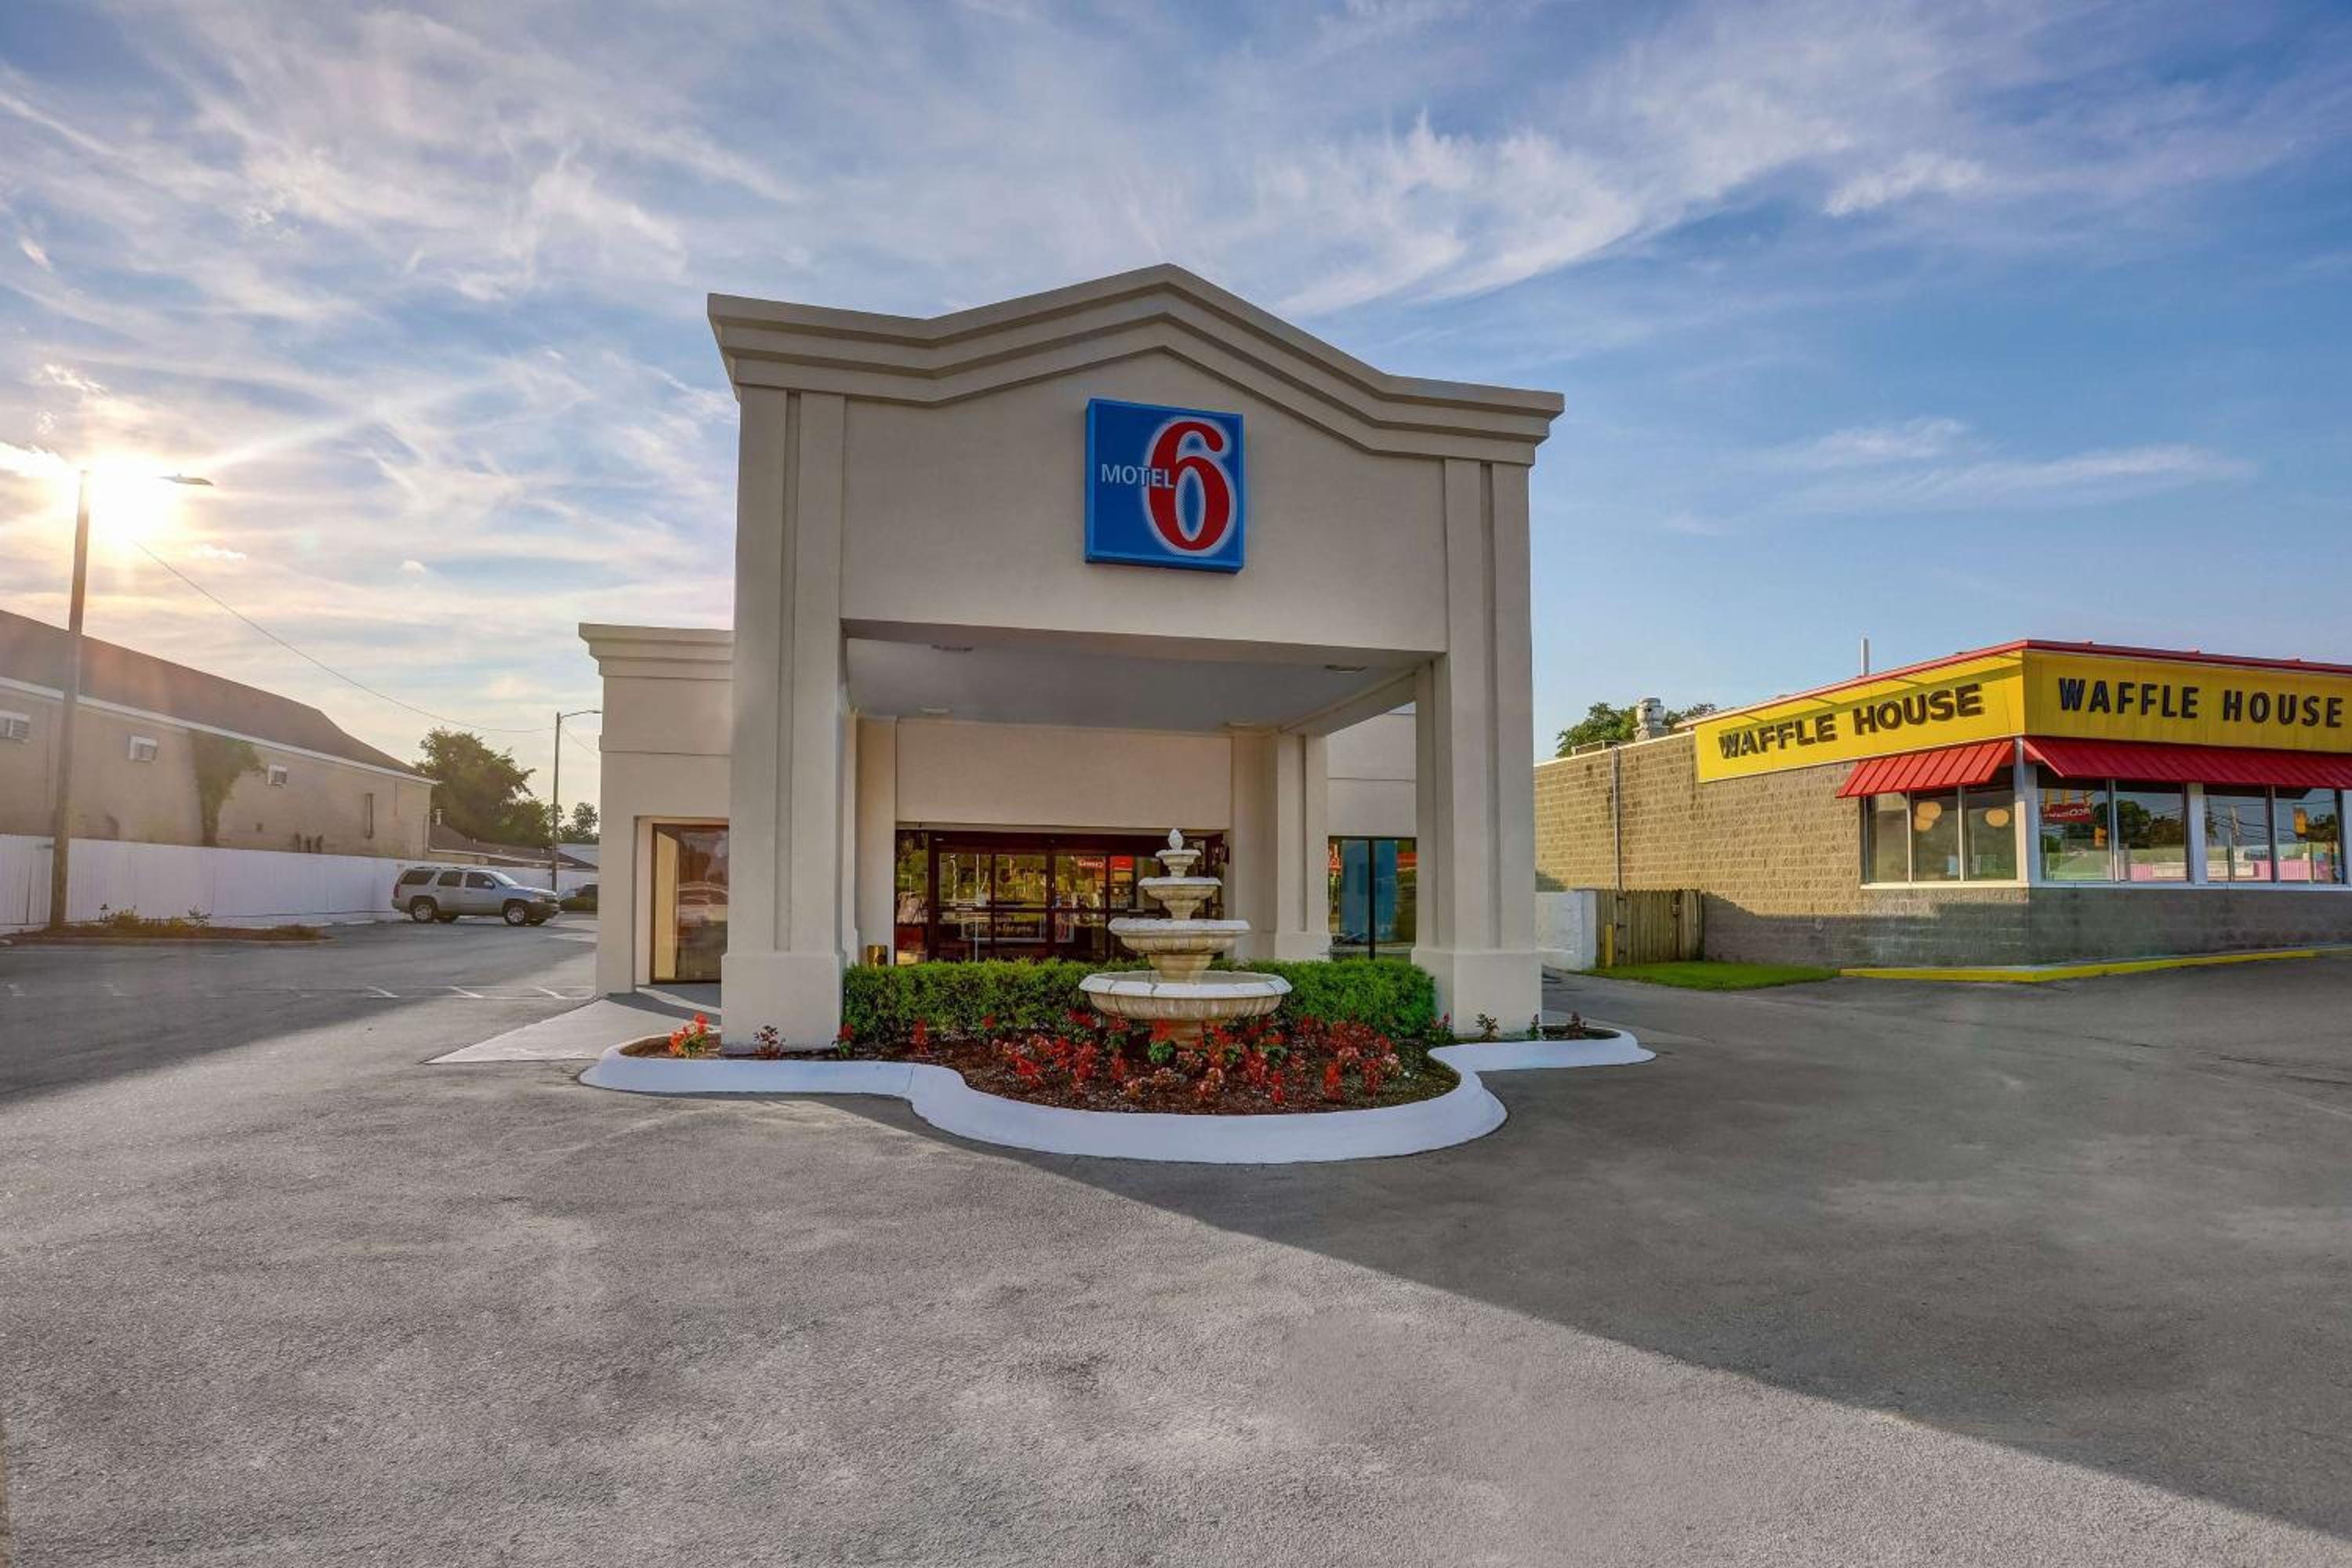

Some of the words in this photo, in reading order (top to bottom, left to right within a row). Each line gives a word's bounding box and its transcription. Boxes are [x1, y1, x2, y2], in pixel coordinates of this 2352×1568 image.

[1101, 463, 1176, 489] MOTEL
[1142, 416, 1238, 556] 6
[1719, 713, 1837, 759] WAFFLE
[1853, 683, 1984, 735] HOUSE
[2058, 677, 2200, 719] WAFFLE
[2223, 689, 2343, 728] HOUSE
